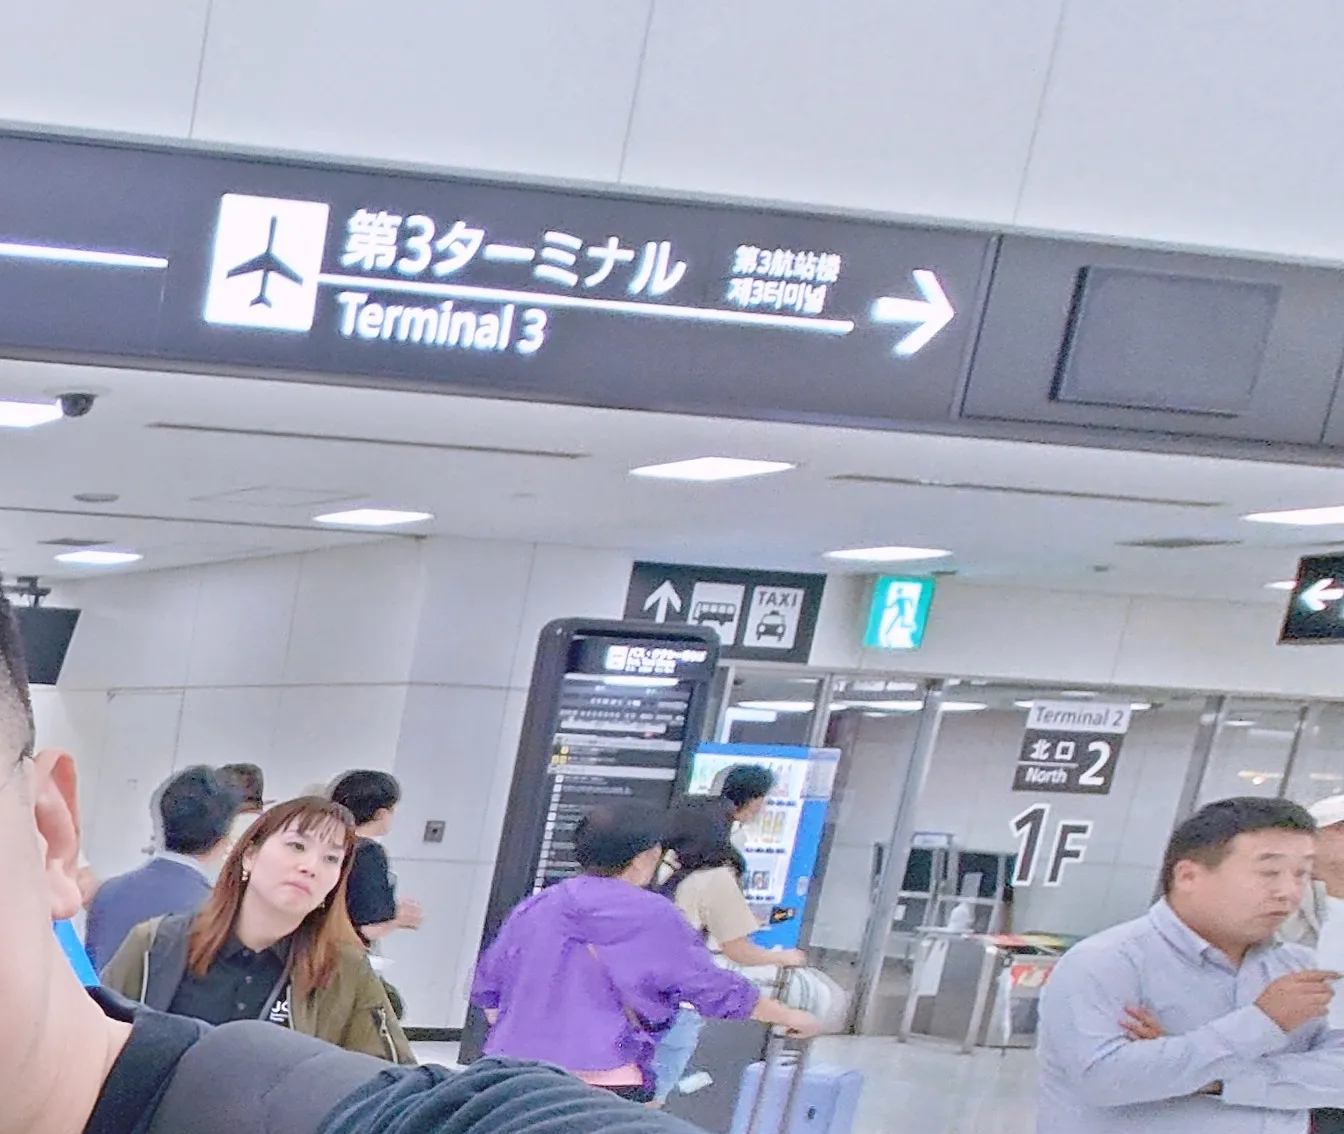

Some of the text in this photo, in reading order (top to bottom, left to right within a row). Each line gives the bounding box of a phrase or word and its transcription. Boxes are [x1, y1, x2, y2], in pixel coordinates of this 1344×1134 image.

[342, 208, 687, 298] 第3ターミナル
[727, 278, 827, 314] 제3터미널
[337, 292, 547, 354] Terminal 3
[757, 590, 800, 608] TAXI
[1034, 706, 1124, 727] Terminal 2
[1029, 738, 1076, 762] 北口
[1078, 741, 1112, 787] 2
[1024, 767, 1067, 785] North
[1009, 802, 1094, 888] 1F
